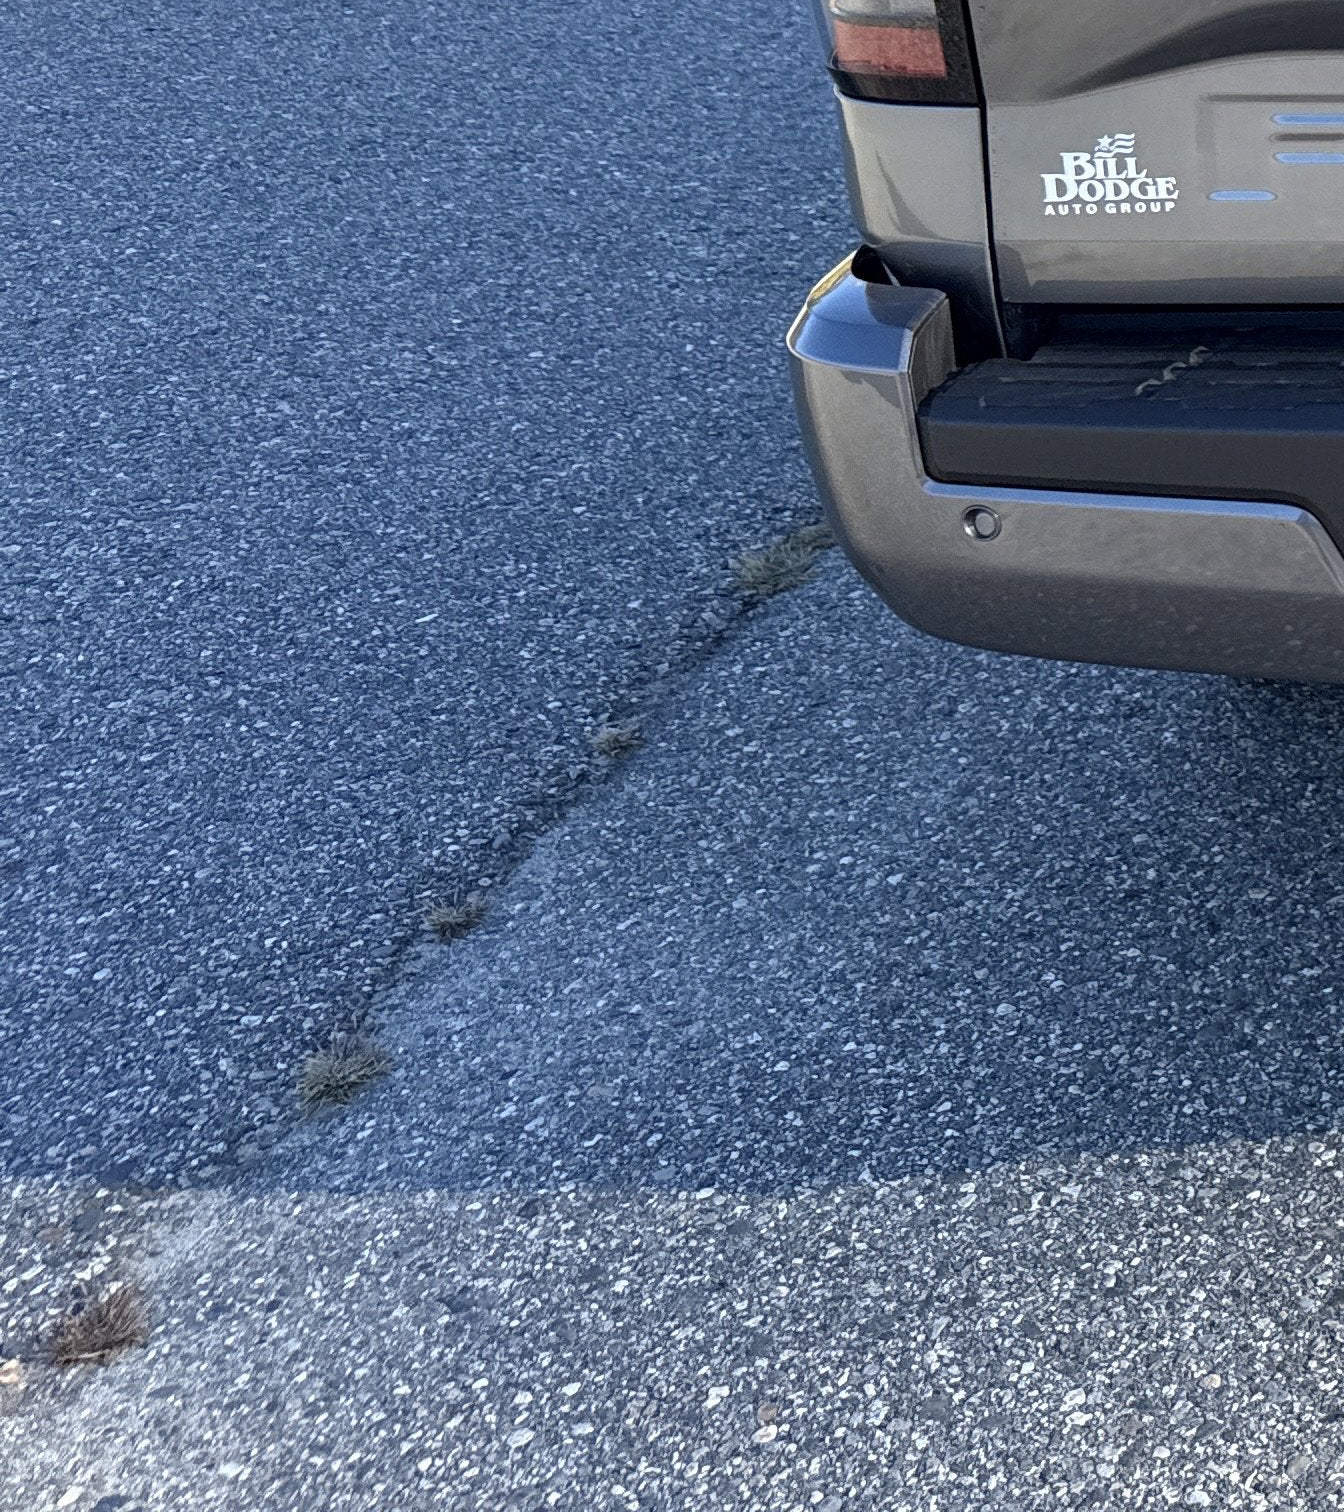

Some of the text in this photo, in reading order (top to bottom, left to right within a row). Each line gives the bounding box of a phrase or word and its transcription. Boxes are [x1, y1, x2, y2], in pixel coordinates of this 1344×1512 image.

[1059, 152, 1148, 180] BILL
[1040, 173, 1180, 202] DODGE
[1044, 201, 1176, 216] AUTO GROUP
